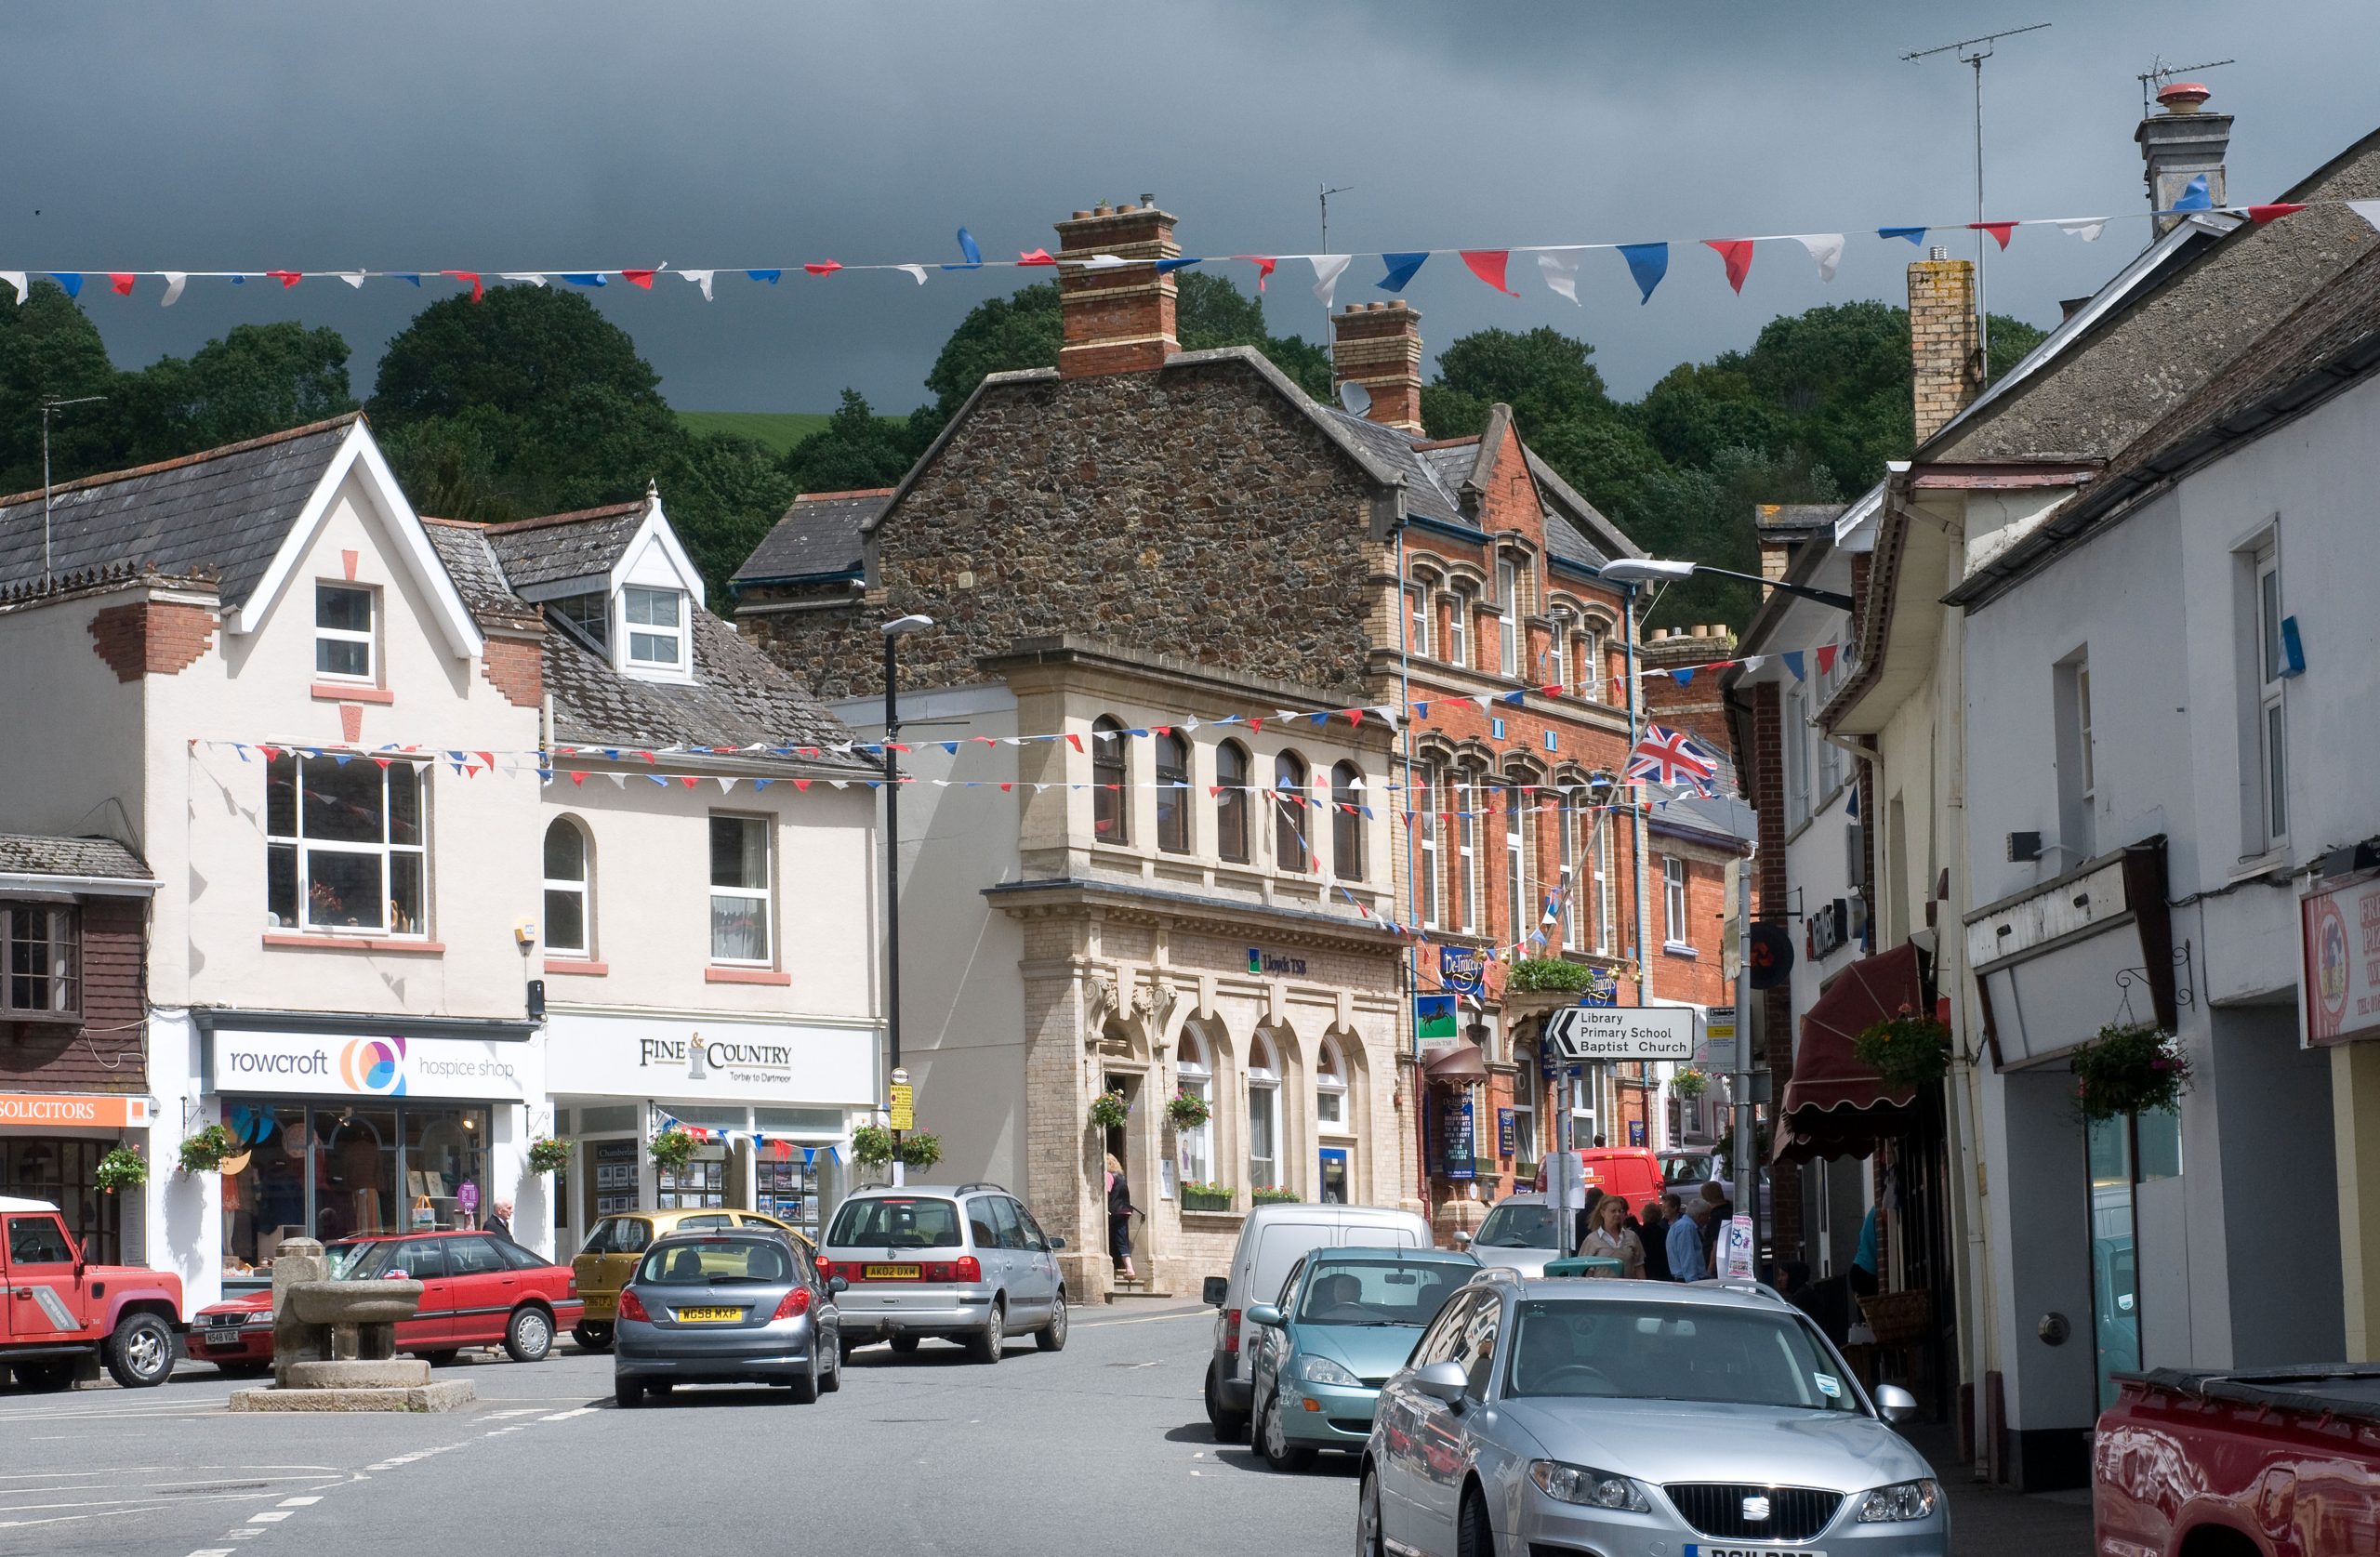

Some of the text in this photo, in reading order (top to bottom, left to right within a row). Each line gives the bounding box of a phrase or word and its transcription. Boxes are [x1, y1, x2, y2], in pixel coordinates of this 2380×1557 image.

[1263, 954, 1307, 980] Lloyds TSB
[1580, 1012, 1623, 1025] Library
[1580, 1027, 1672, 1040] Primary School
[1423, 1039, 1441, 1048] Lloyds
[1580, 1041, 1686, 1053] Baptist Church
[640, 1032, 792, 1070] FINE & COUNTRY
[230, 1049, 515, 1080] rowcroft hospice shop
[730, 1071, 792, 1084] Torbay to Dartmoor
[870, 1266, 916, 1276] AK02 DXW
[682, 1308, 737, 1320] WG58 MXP
